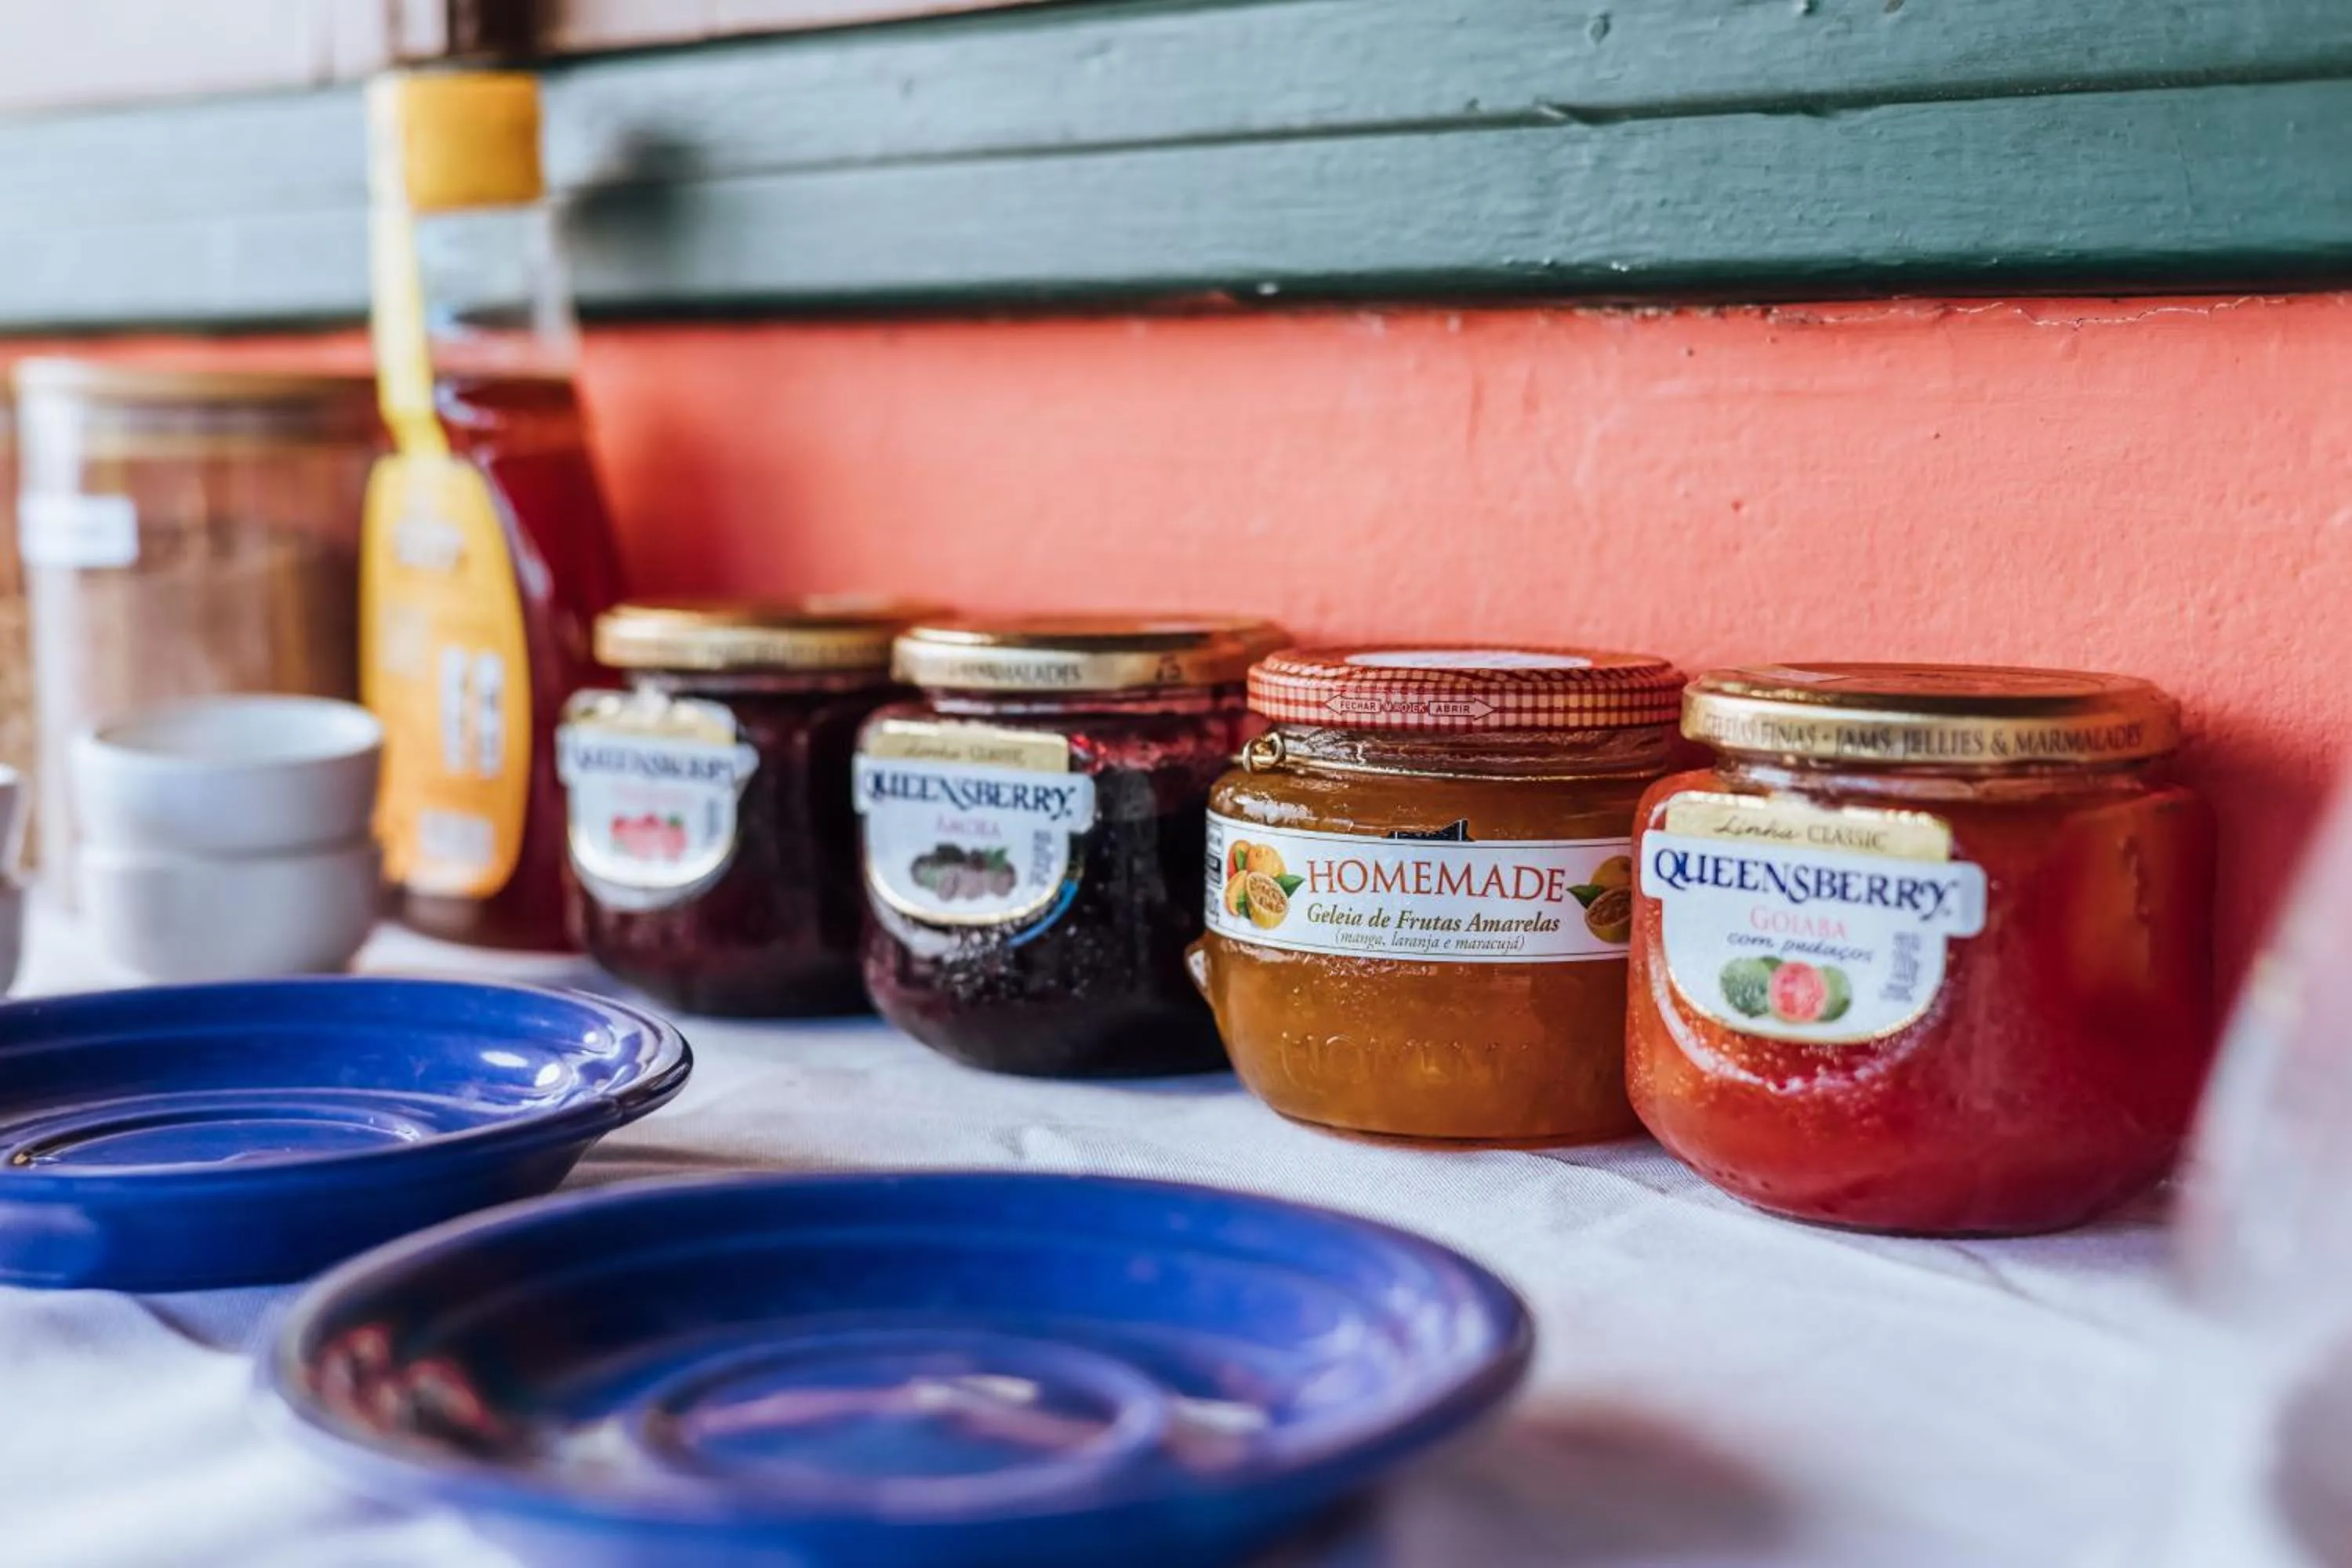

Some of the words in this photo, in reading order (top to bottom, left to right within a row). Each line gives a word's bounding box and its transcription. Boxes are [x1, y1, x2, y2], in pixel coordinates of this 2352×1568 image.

[1340, 700, 1376, 711] FECHAR
[1436, 704, 1471, 714] ABRIR
[1902, 726, 1985, 758] JELLIES
[1990, 727, 2009, 757] &
[2013, 720, 2143, 755] MARMALADES
[866, 769, 1076, 822] QUEENSBERRY
[1713, 815, 1802, 840] Linha
[1806, 823, 1889, 850] CLASSIC
[1306, 858, 1566, 902] HOMEMADE
[1653, 848, 1958, 921] QUEENSBERRY
[1307, 902, 1362, 927] Geleia
[1367, 907, 1391, 928] de
[1395, 909, 1461, 933] Frutas
[1465, 910, 1560, 933] Amarelas
[1749, 904, 1849, 938] GOIABA
[1391, 931, 1439, 952] laranja
[1443, 937, 1451, 949] e
[1454, 933, 1526, 953] maracujá)
[1726, 930, 1775, 949] com
